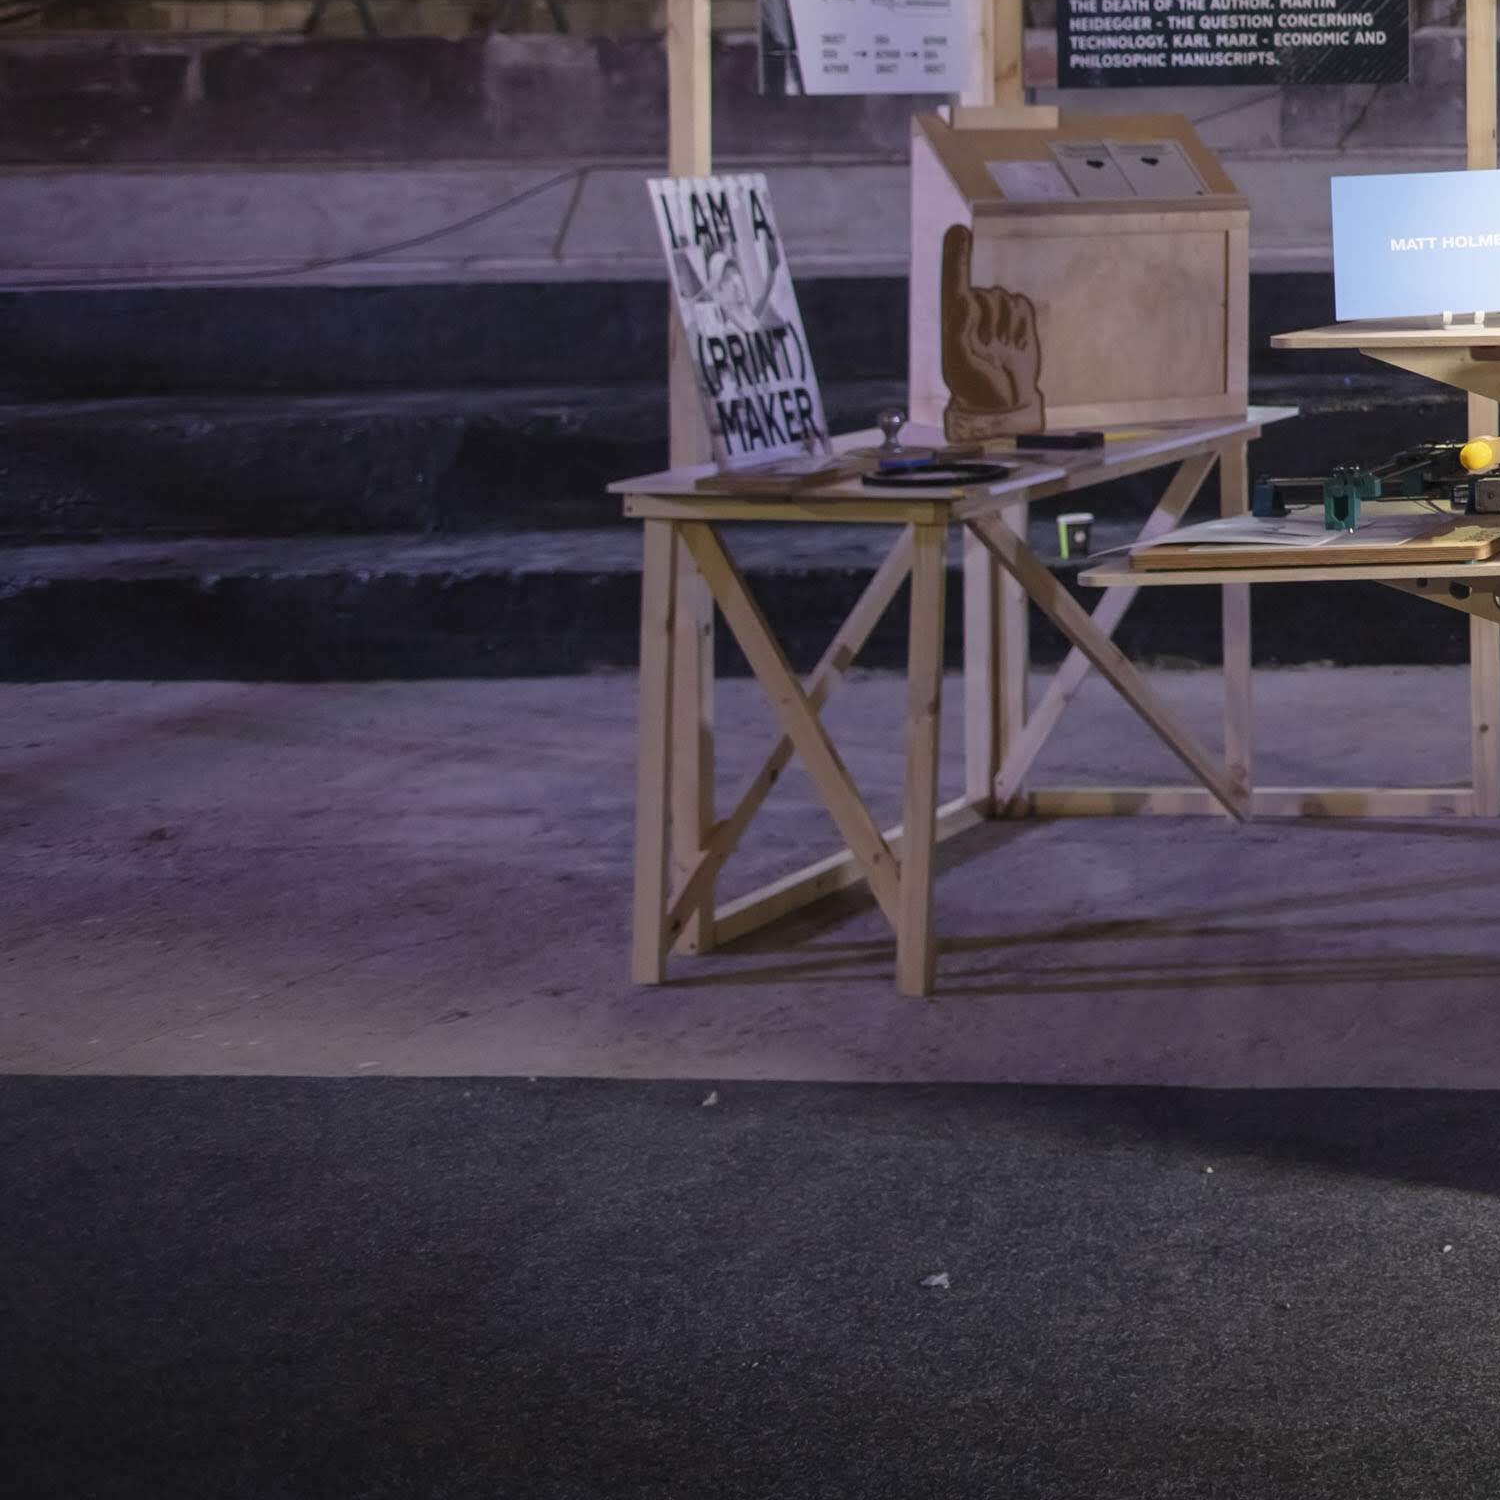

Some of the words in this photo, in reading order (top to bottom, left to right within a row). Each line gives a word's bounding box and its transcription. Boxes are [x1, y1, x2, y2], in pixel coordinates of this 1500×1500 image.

[1070, 16, 1152, 31] HEIDEGGER
[1167, 16, 1195, 29] THE
[1199, 14, 1273, 29] QUESTION
[1278, 13, 1374, 27] CONCERNING
[1070, 35, 1168, 50] TECHNOLOGY.
[1173, 34, 1210, 48] KARL
[1216, 33, 1258, 47] MARX
[1274, 32, 1350, 46] ECONOMIC
[1354, 31, 1387, 45] AND
[1070, 53, 1167, 68] PHILOSOPHIC
[1172, 52, 1281, 67] MANUSCRIPTS.
[659, 192, 679, 250] I
[689, 190, 738, 248] AM
[748, 188, 775, 242] A
[1390, 236, 1438, 252] MATT
[696, 321, 808, 397] (PRINT)
[715, 388, 823, 457] MAKER
